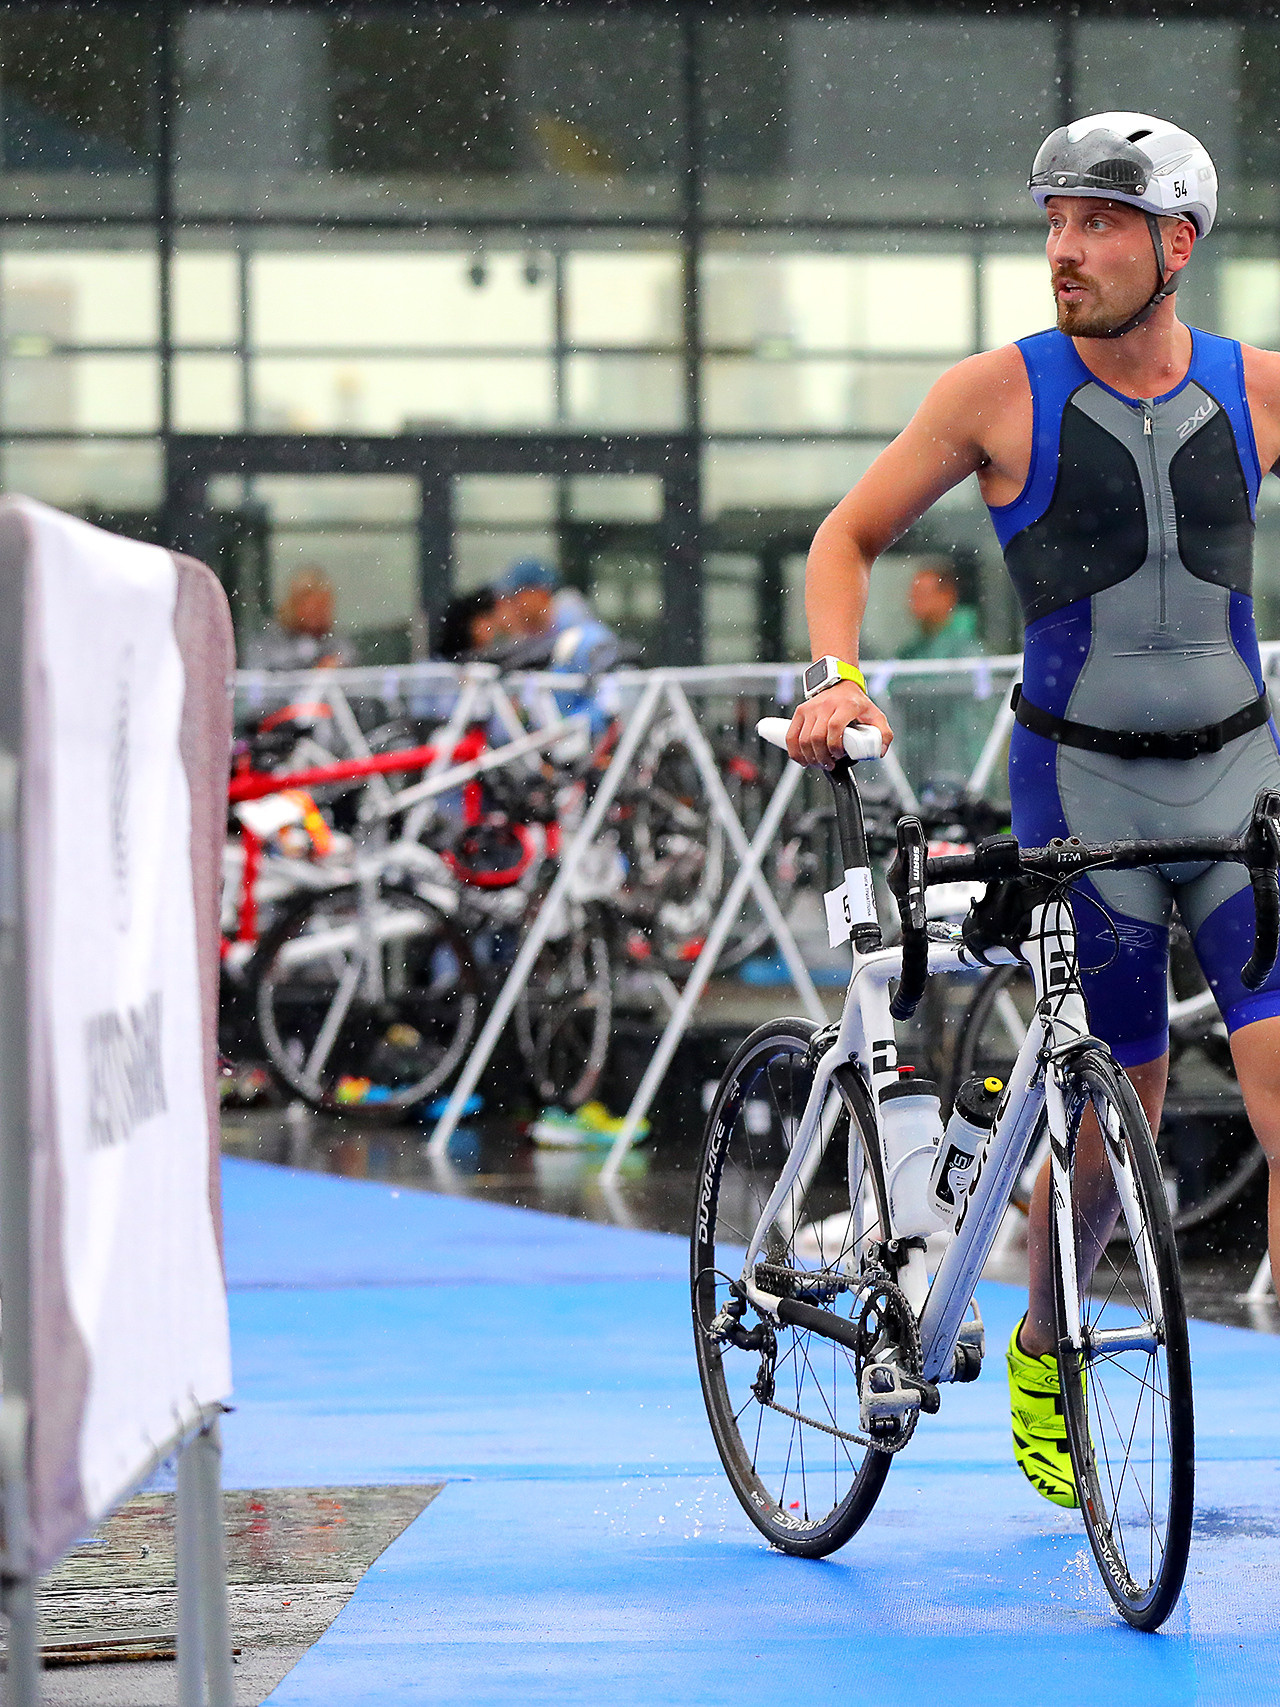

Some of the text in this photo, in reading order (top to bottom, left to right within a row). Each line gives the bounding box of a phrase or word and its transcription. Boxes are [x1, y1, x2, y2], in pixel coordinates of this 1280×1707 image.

[1173, 180, 1187, 198] 54
[1176, 397, 1213, 439] 2XU
[699, 1118, 726, 1244] DURA-ACE
